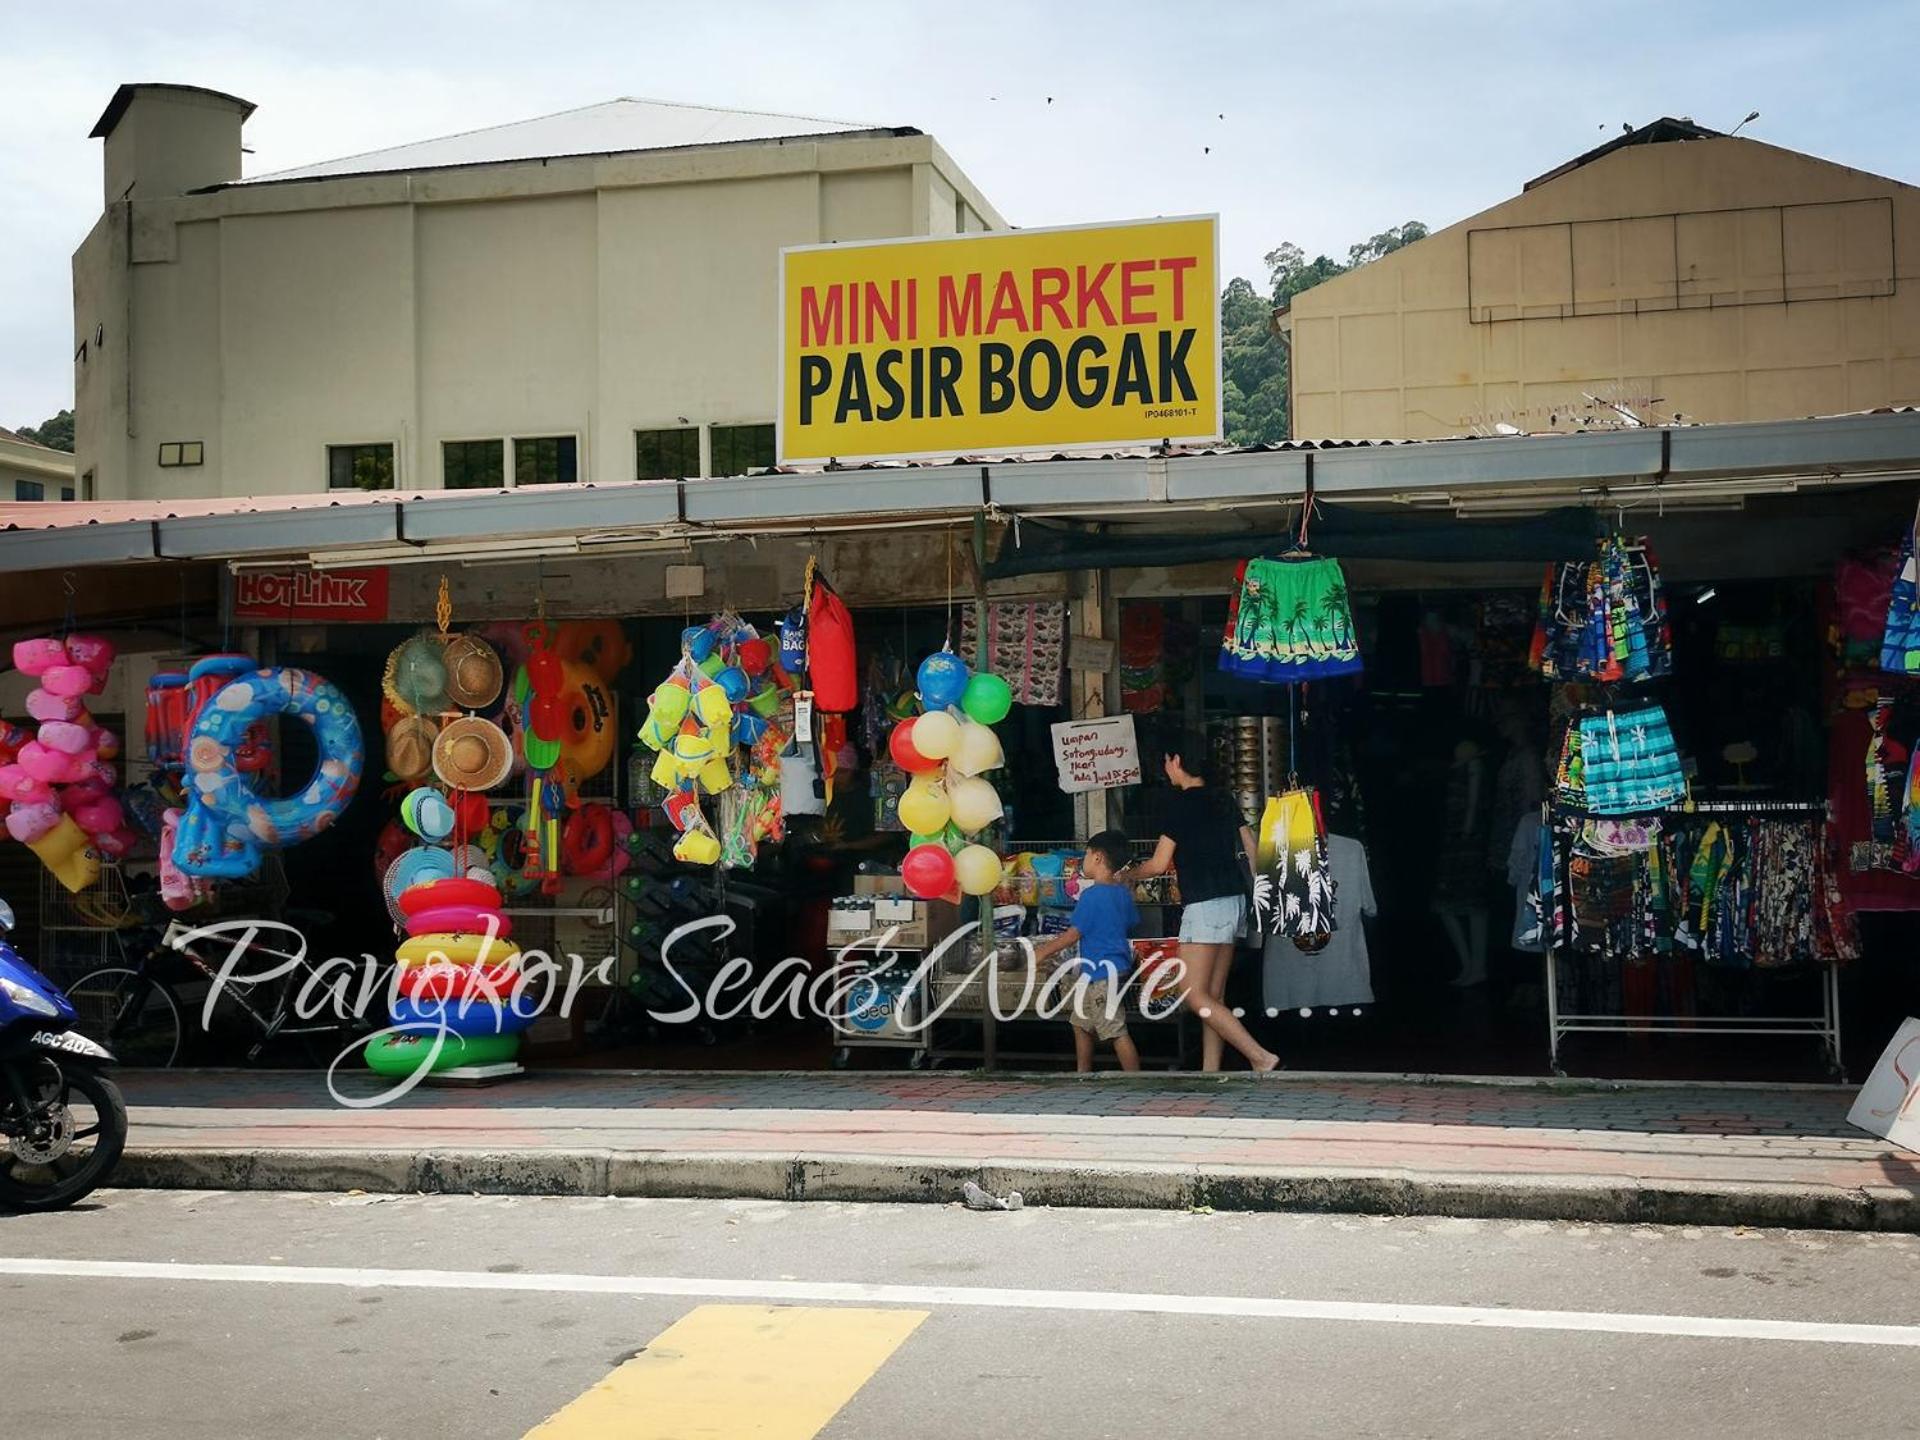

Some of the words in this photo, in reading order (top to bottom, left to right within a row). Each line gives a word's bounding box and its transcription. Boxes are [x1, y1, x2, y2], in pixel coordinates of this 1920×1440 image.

[800, 277, 917, 348] MINI
[938, 256, 1198, 338] MARKET
[799, 346, 964, 426] PASIR
[978, 327, 1199, 415] BOGAK
[782, 640, 805, 651] BAG
